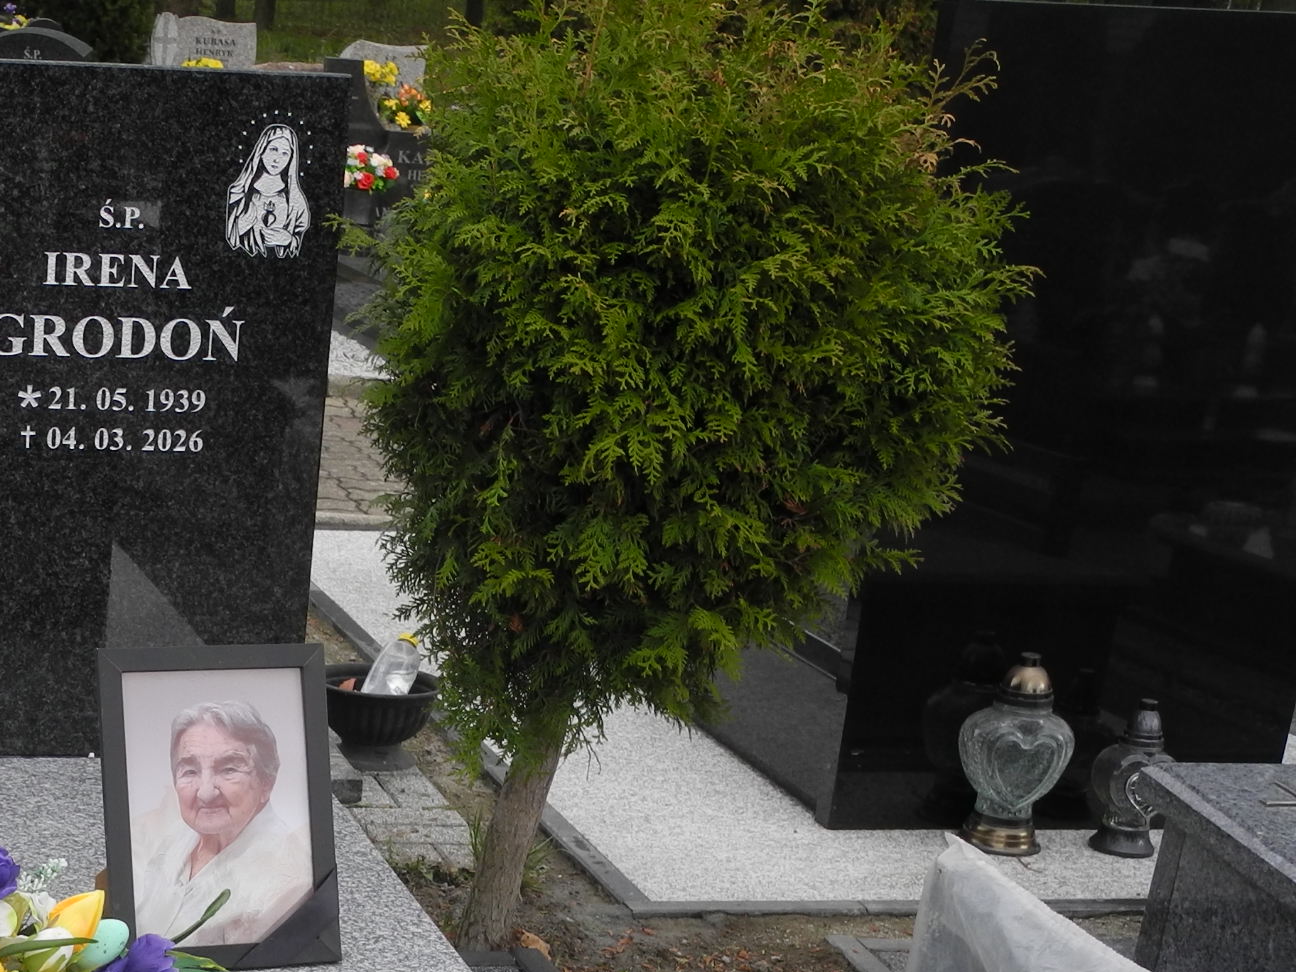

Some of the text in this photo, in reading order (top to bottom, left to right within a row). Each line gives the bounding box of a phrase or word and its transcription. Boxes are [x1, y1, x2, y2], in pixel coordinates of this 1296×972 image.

[23, 46, 42, 60] Ś.P.
[98, 199, 145, 230] Ś.P.
[42, 251, 192, 290] IRENA
[47, 386, 206, 413] 21. 05. 1939
[46, 426, 204, 453] 04. 03. 2026
